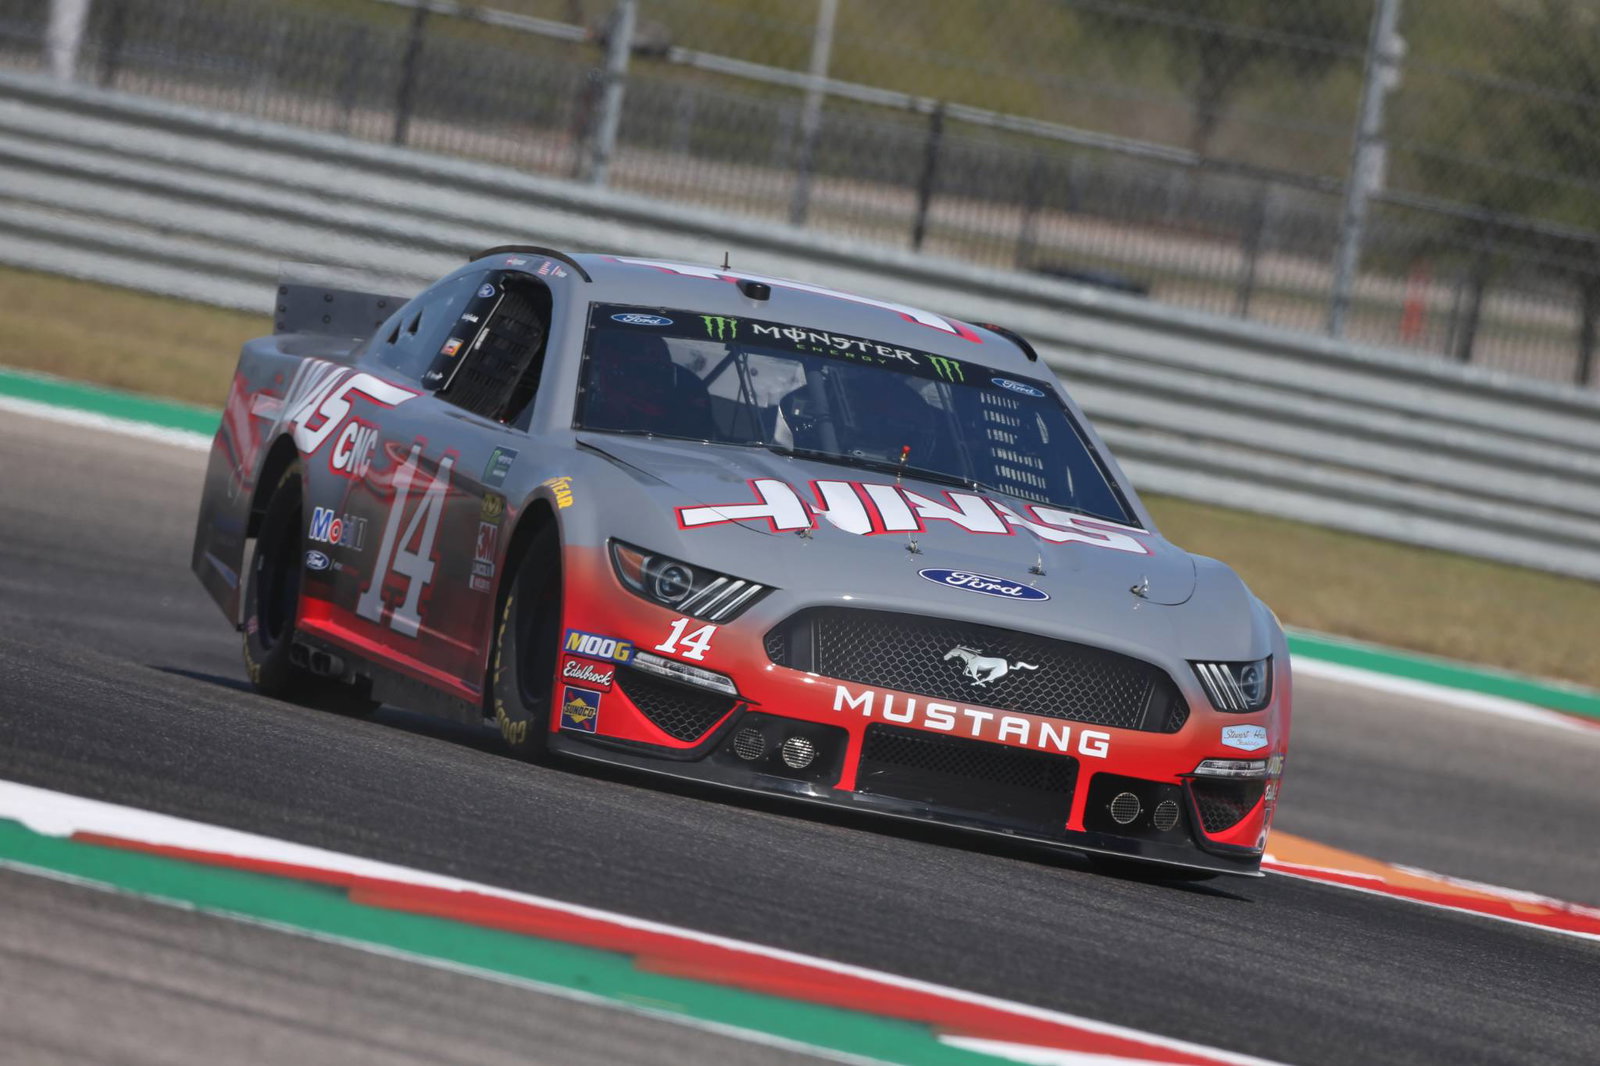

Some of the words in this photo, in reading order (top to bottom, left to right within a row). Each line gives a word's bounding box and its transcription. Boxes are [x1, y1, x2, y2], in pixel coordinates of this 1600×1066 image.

[751, 323, 920, 366] MONSTER
[796, 343, 887, 365] ENERGY
[332, 421, 379, 478] CNC
[356, 444, 455, 638] 14
[944, 571, 1023, 598] Ford
[565, 632, 632, 662] MOOG
[654, 617, 718, 661] 14
[563, 660, 613, 686] Edelbrock
[564, 703, 595, 718] SUNOCO
[833, 686, 1111, 759] MUSTANG
